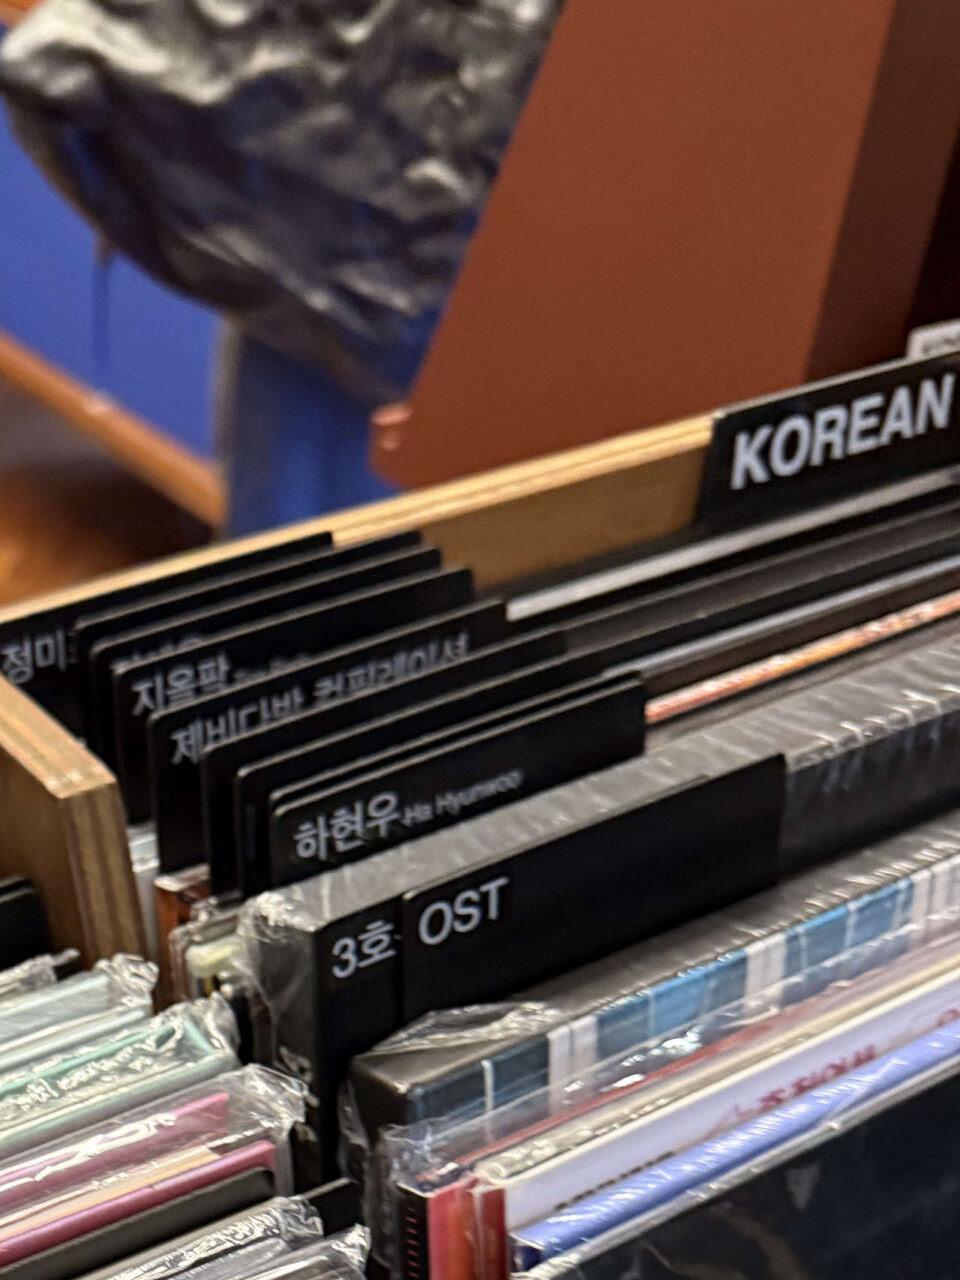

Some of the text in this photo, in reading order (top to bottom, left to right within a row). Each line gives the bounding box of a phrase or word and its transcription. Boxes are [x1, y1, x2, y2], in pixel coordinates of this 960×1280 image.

[730, 372, 956, 490] KOREAN
[1, 628, 79, 684] 정미
[293, 791, 401, 861] 하현우
[418, 876, 510, 946] OST
[331, 919, 402, 979] 3호
